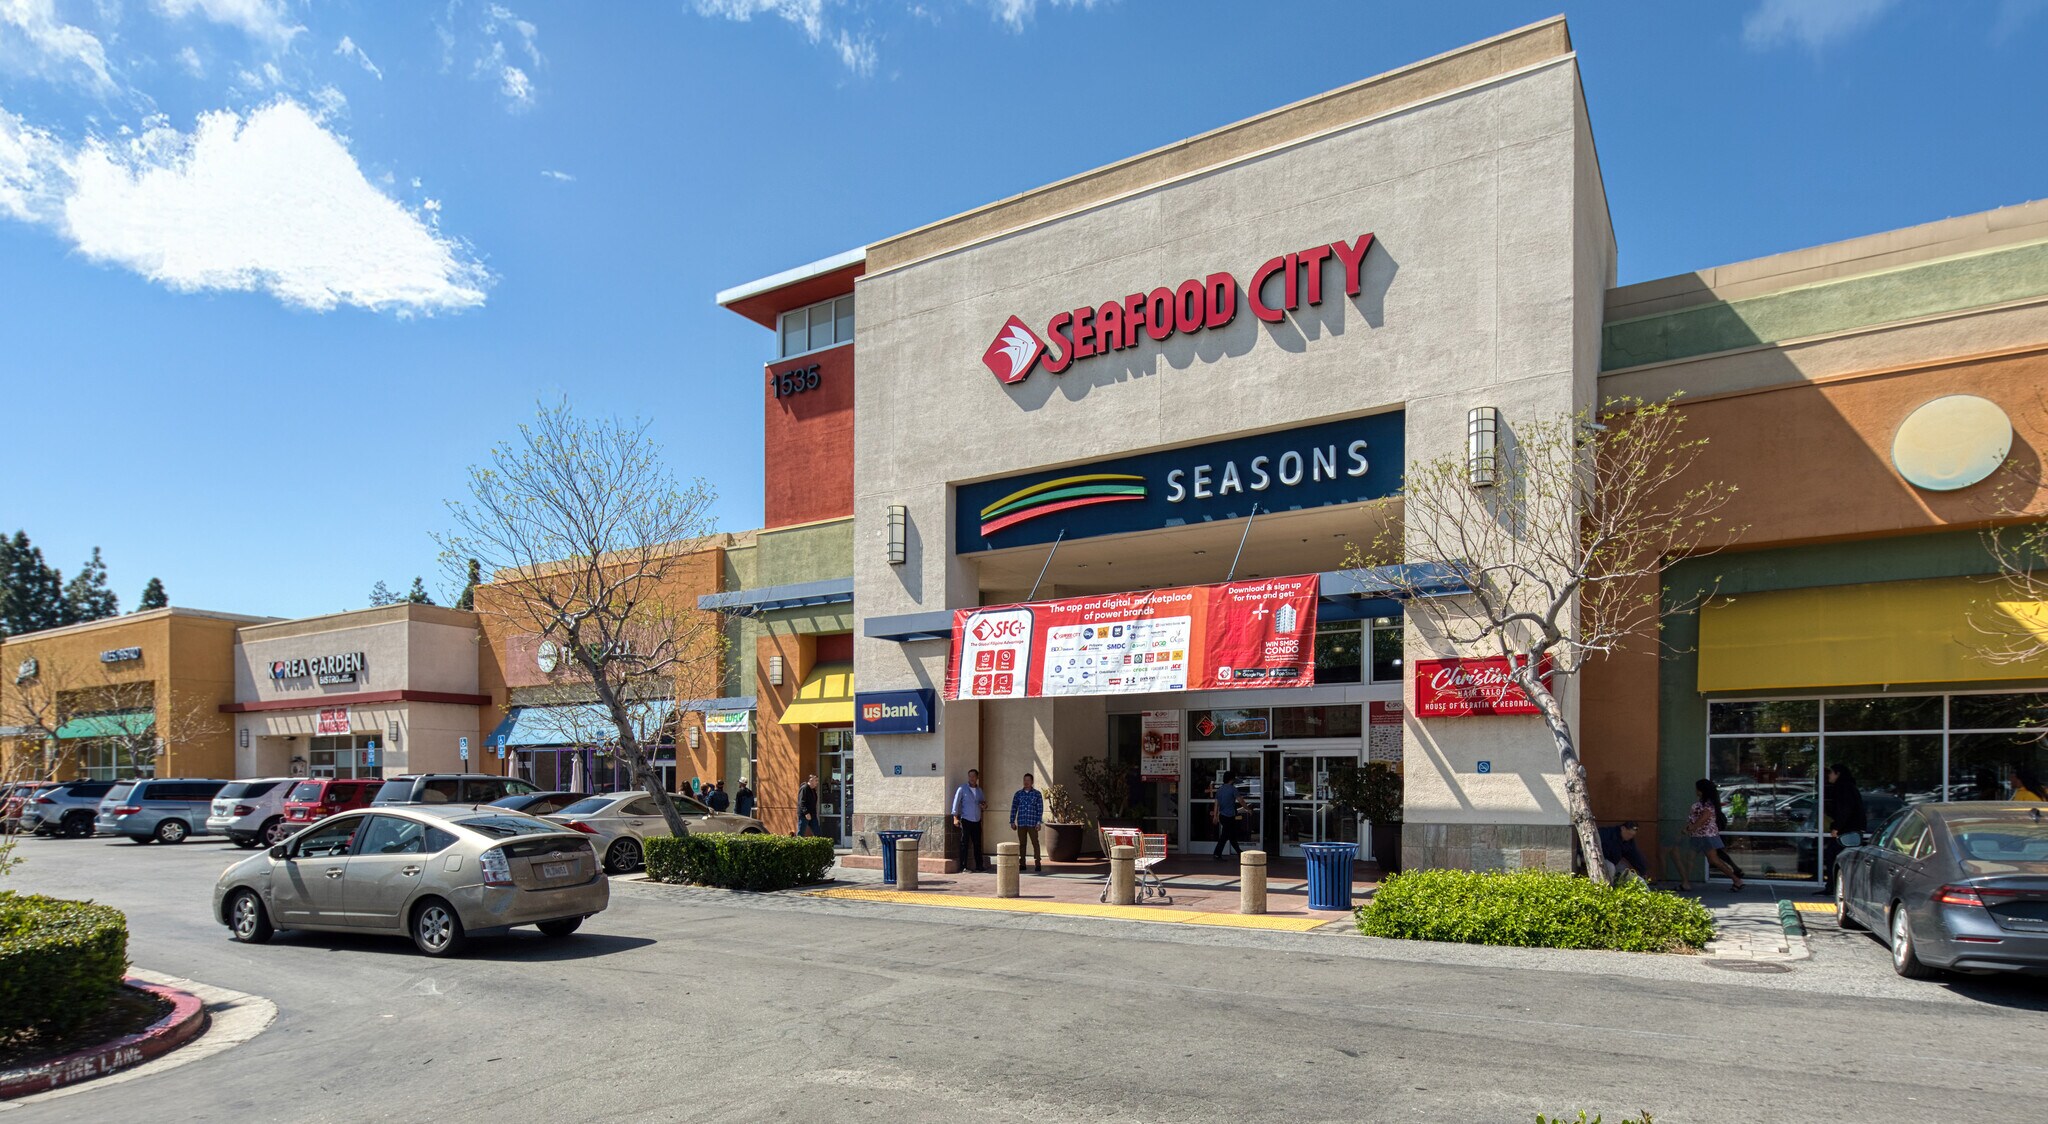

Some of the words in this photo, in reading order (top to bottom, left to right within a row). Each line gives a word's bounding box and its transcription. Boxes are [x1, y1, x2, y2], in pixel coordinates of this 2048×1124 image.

[1041, 271, 1238, 375] SEAFOOD
[1248, 232, 1375, 324] CITY
[770, 364, 820, 399] 1535
[1166, 439, 1369, 503] SEASONS
[1228, 585, 1265, 594] Download
[1266, 583, 1273, 591] &
[1274, 582, 1290, 591] sign
[1291, 582, 1302, 590] up
[1050, 604, 1065, 613] The
[1066, 603, 1083, 613] app
[1084, 600, 1101, 610] and
[1102, 597, 1131, 609] digital
[1134, 592, 1193, 606] marketplace
[1246, 593, 1262, 601] free
[1279, 591, 1295, 600] get:
[1084, 611, 1094, 620] of
[1095, 610, 1122, 621] power
[1123, 606, 1155, 617] brands
[993, 620, 1026, 638] SFC+
[1279, 639, 1299, 647] SMDC
[1265, 646, 1299, 655] CONDO
[267, 658, 308, 680] KOREA
[309, 652, 363, 676] GARDEN
[319, 674, 339, 685] BISTRO
[1458, 689, 1477, 697] HAIR
[1425, 702, 1446, 710] HOUSE
[1460, 701, 1490, 709] KERATIN
[706, 712, 747, 723] SUBWAY
[100, 1048, 143, 1073] LANE
